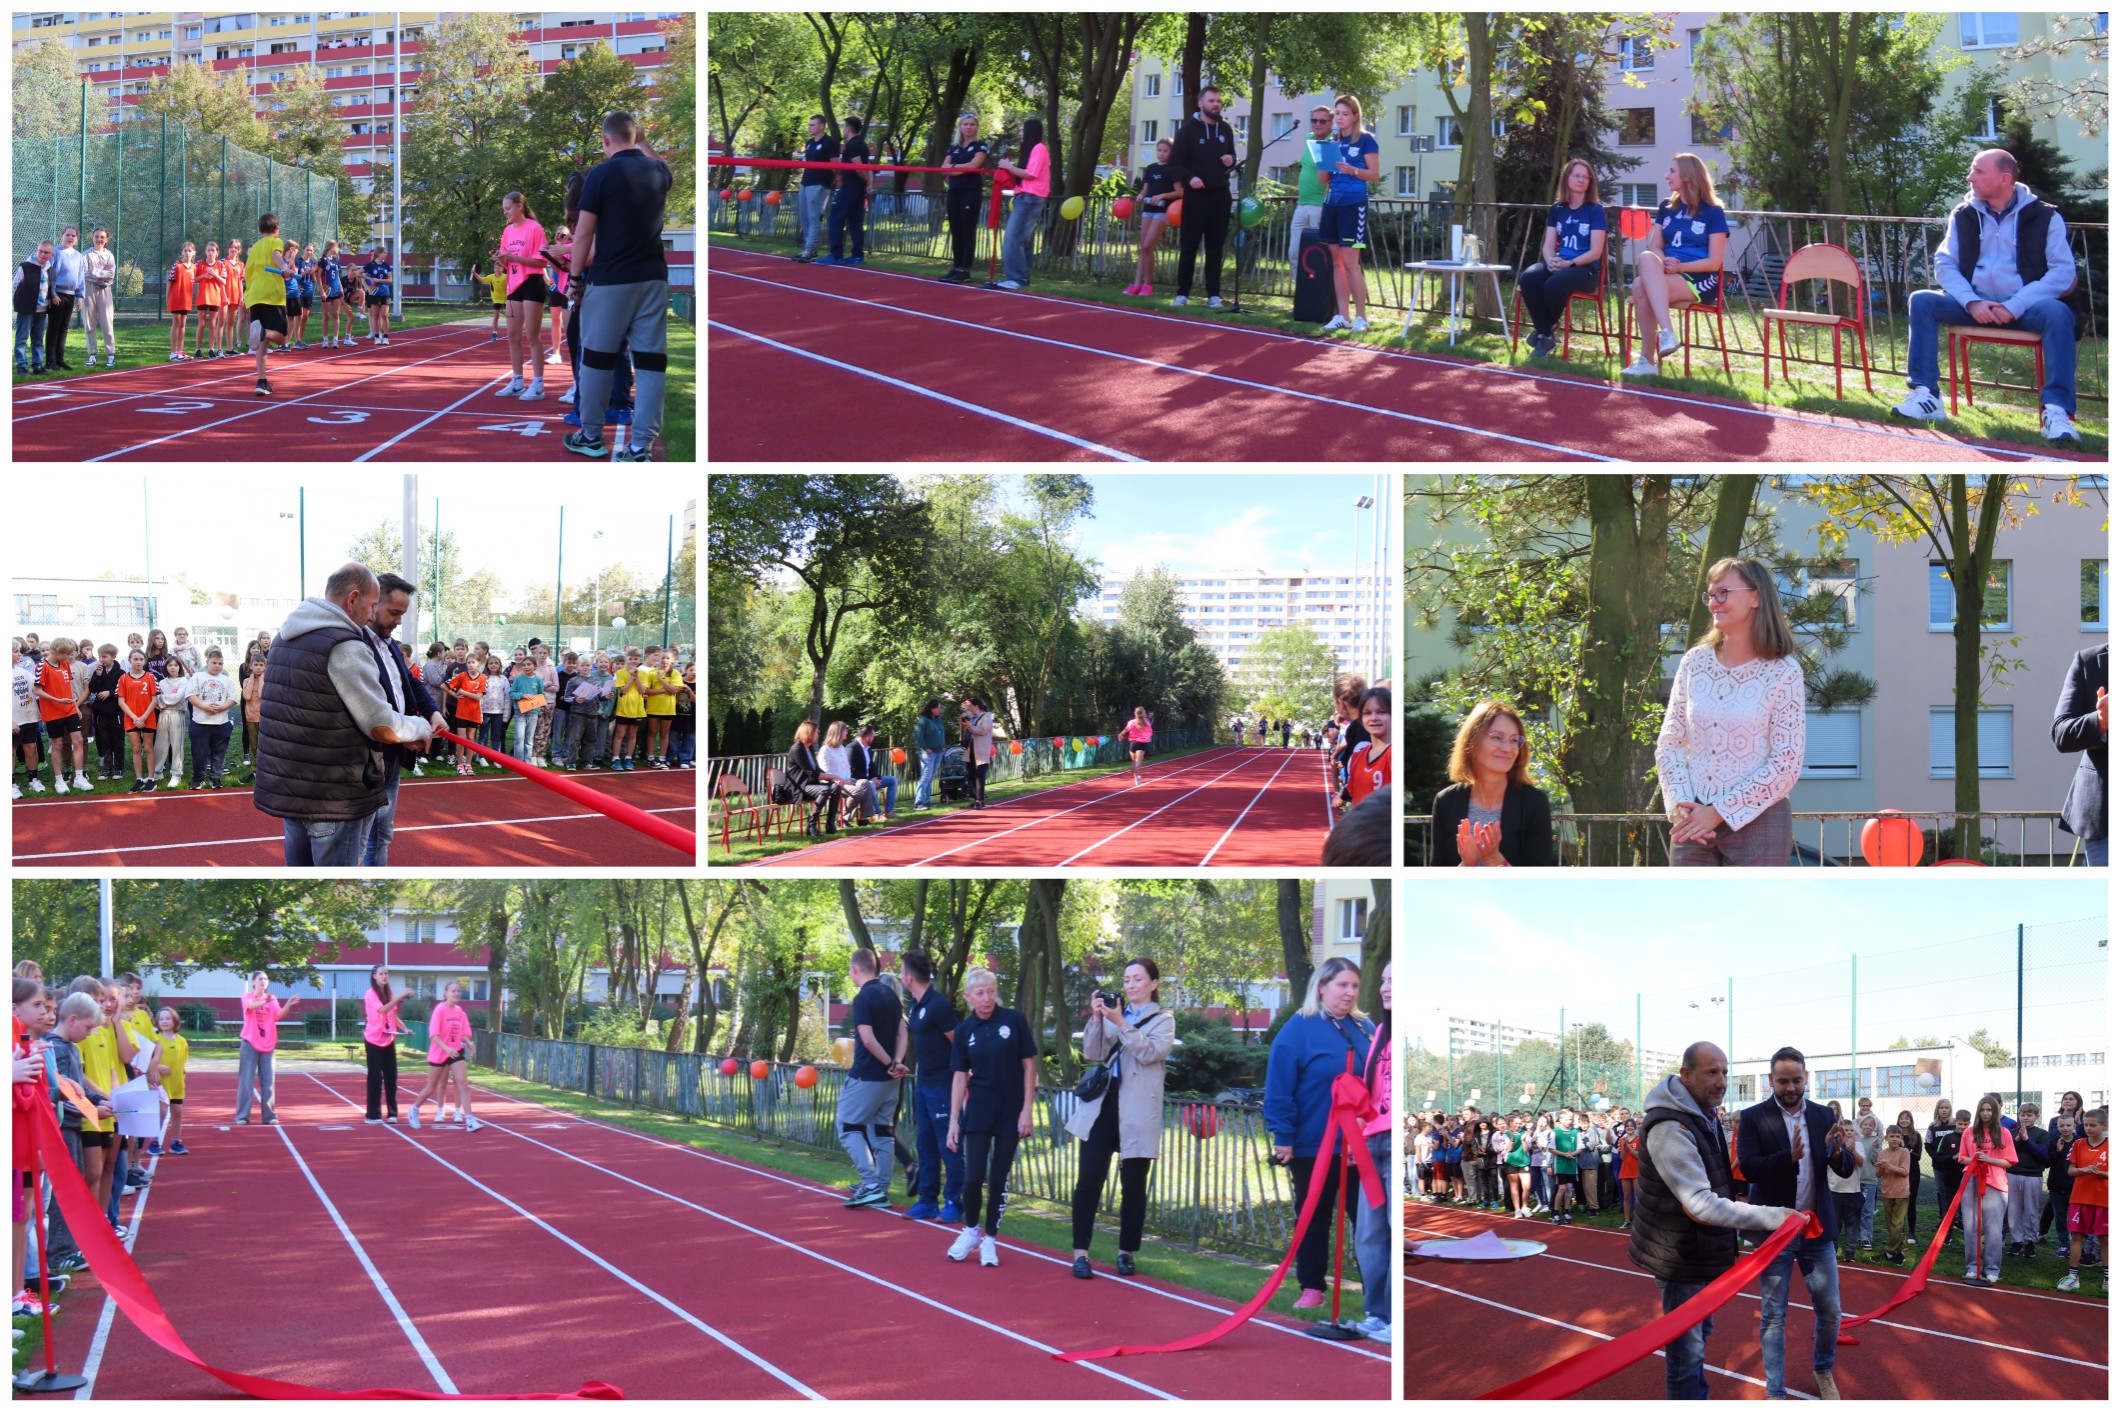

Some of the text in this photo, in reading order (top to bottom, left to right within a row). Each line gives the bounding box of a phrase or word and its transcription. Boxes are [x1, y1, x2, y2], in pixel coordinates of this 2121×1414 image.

[331, 270, 336, 279] 5
[134, 401, 214, 414] 2
[307, 411, 371, 424] 3
[477, 421, 552, 437] 4
[142, 682, 149, 691] 2
[1373, 770, 1383, 791] 9
[2099, 1151, 2107, 1162] 4
[2072, 1212, 2080, 1224] 4
